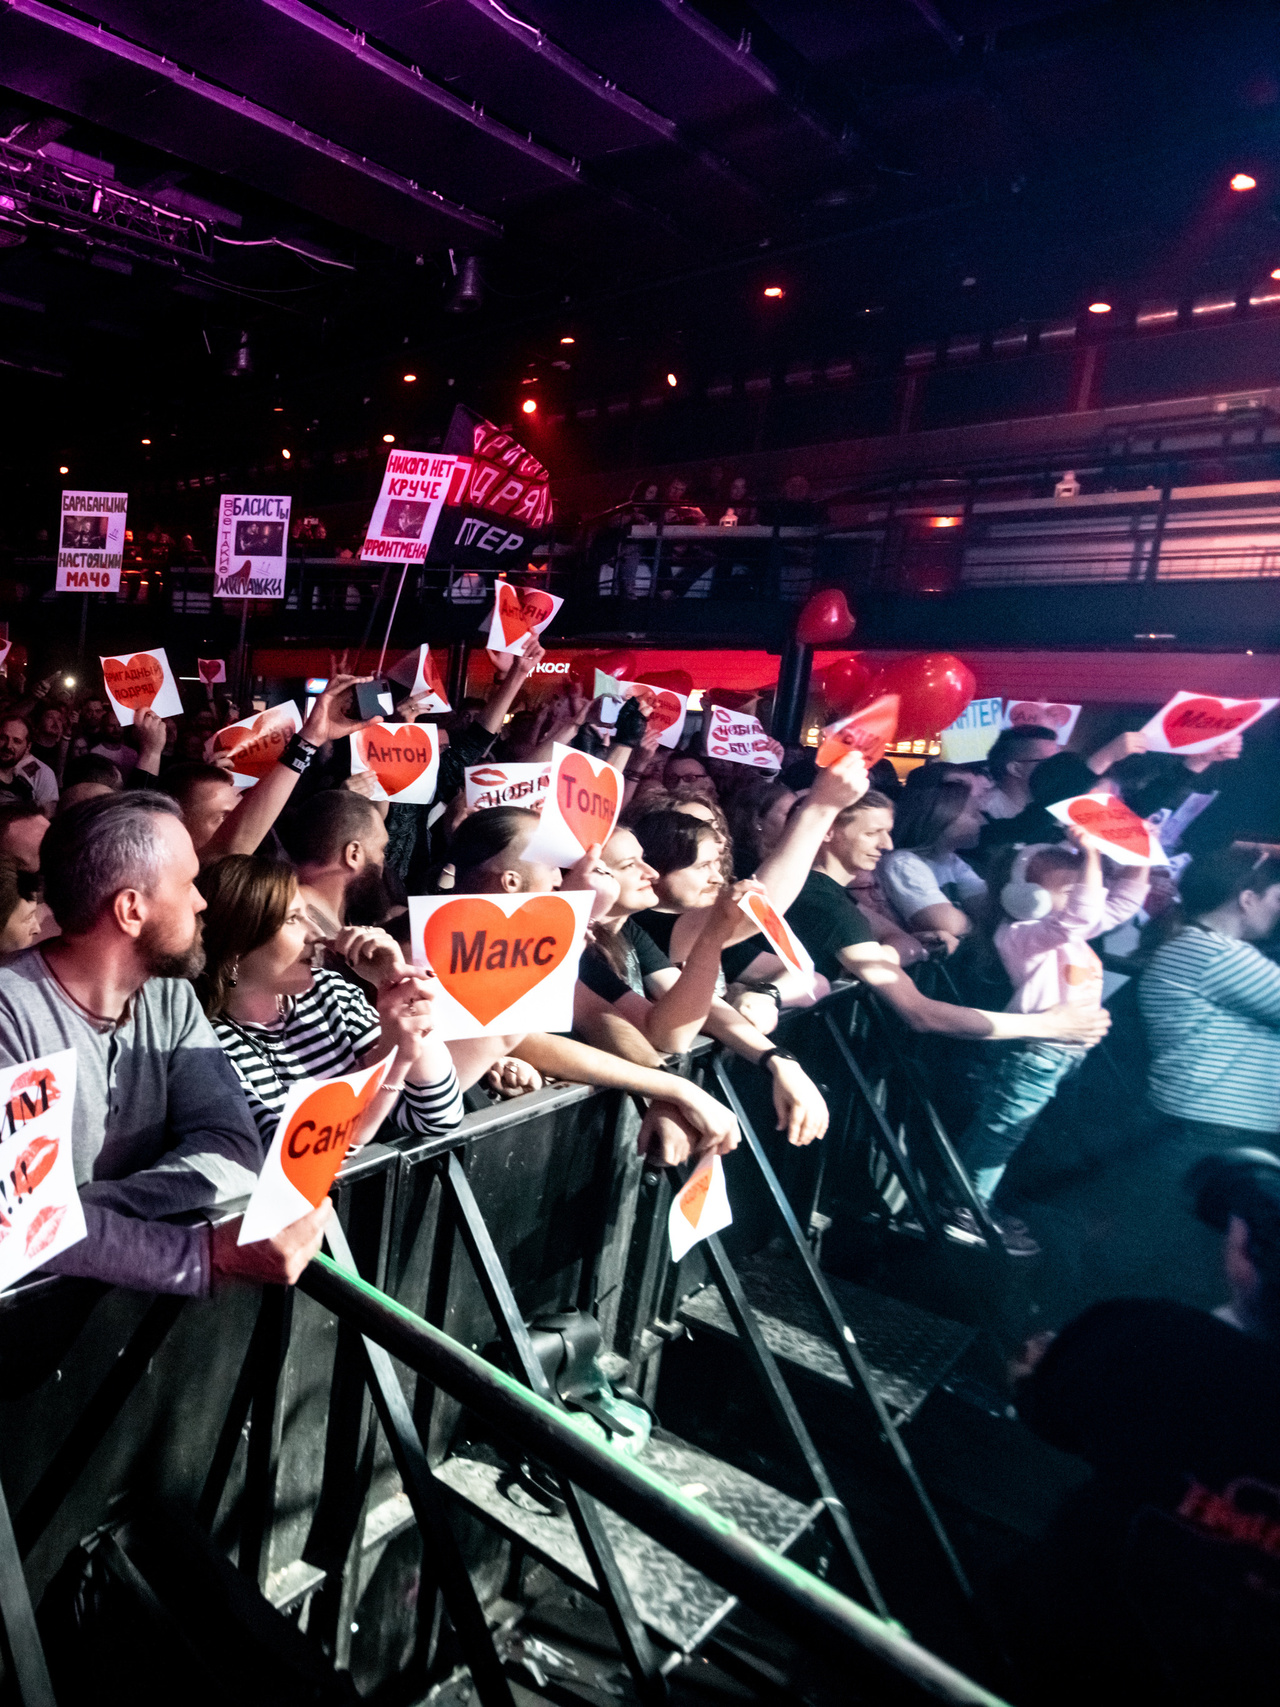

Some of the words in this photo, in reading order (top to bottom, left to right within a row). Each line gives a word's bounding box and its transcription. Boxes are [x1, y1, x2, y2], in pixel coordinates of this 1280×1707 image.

[387, 455, 429, 476] НИКОГО
[430, 459, 455, 478] НЕТ
[388, 478, 442, 499] КРУЧЕ
[364, 539, 427, 559] ФРОНТМЕНА
[66, 572, 110, 587] МАЧО
[115, 683, 155, 699] ПОДРЯД
[367, 741, 427, 763] Антон
[450, 930, 557, 975] Макс
